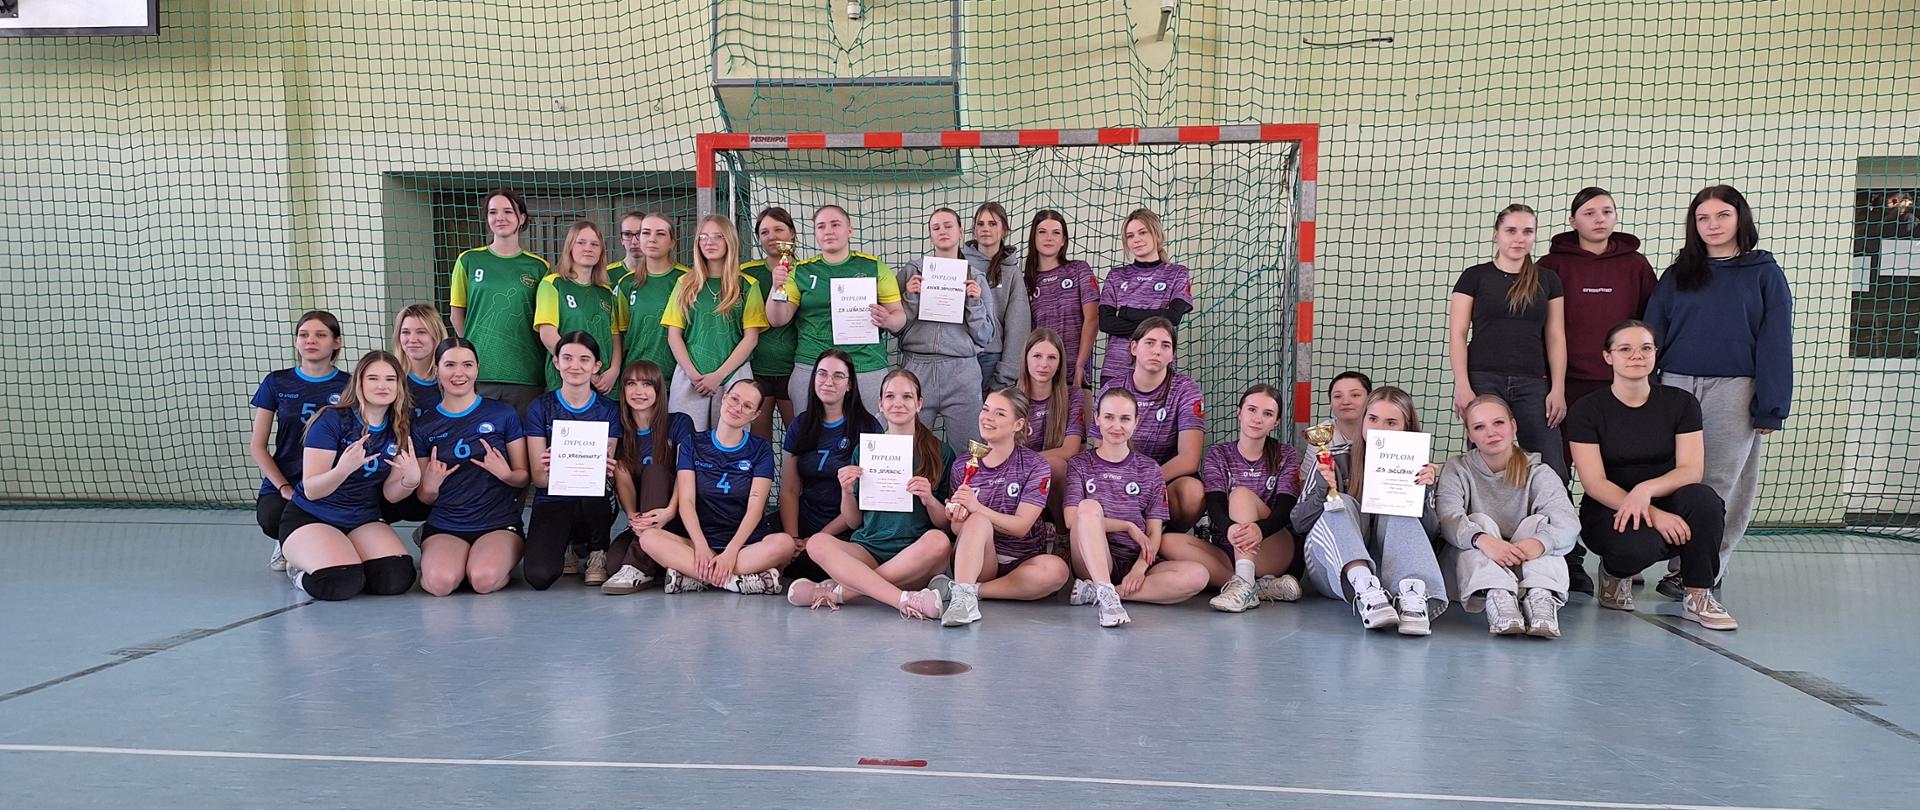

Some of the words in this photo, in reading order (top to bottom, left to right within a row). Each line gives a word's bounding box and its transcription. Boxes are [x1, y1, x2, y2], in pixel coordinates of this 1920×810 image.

[474, 268, 485, 283] 9
[809, 274, 818, 290] 7
[1120, 281, 1129, 292] 4
[566, 294, 578, 310] 8
[300, 402, 317, 425] 5
[453, 438, 472, 459] 6
[817, 449, 830, 472] 7
[1379, 452, 1415, 462] DYPLOM
[716, 472, 731, 494] 4
[1085, 478, 1097, 494] 6
